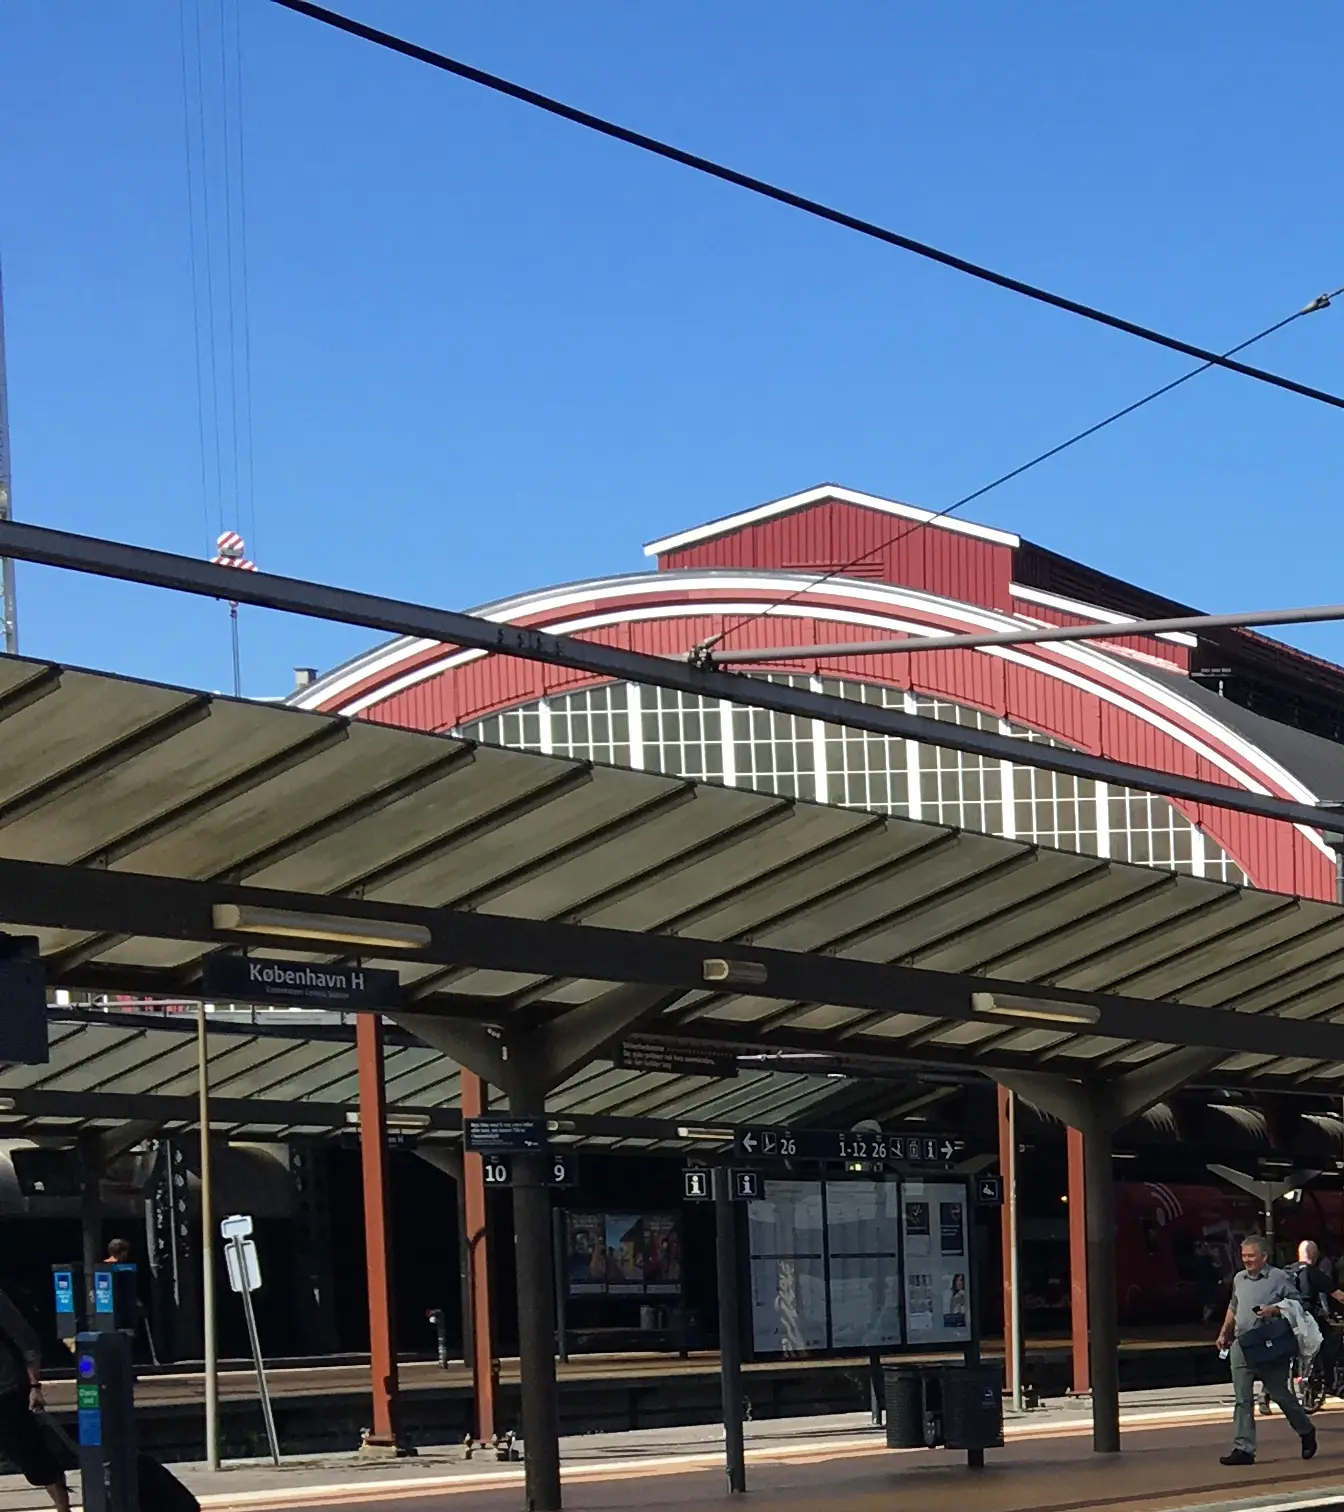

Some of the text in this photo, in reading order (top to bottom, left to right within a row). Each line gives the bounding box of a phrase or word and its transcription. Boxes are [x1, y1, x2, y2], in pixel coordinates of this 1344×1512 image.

[249, 963, 365, 990] København H
[780, 1139, 796, 1155] 26
[838, 1141, 867, 1157] 1-12
[872, 1142, 887, 1158] 26
[485, 1164, 507, 1182] 10
[553, 1164, 565, 1182] 9
